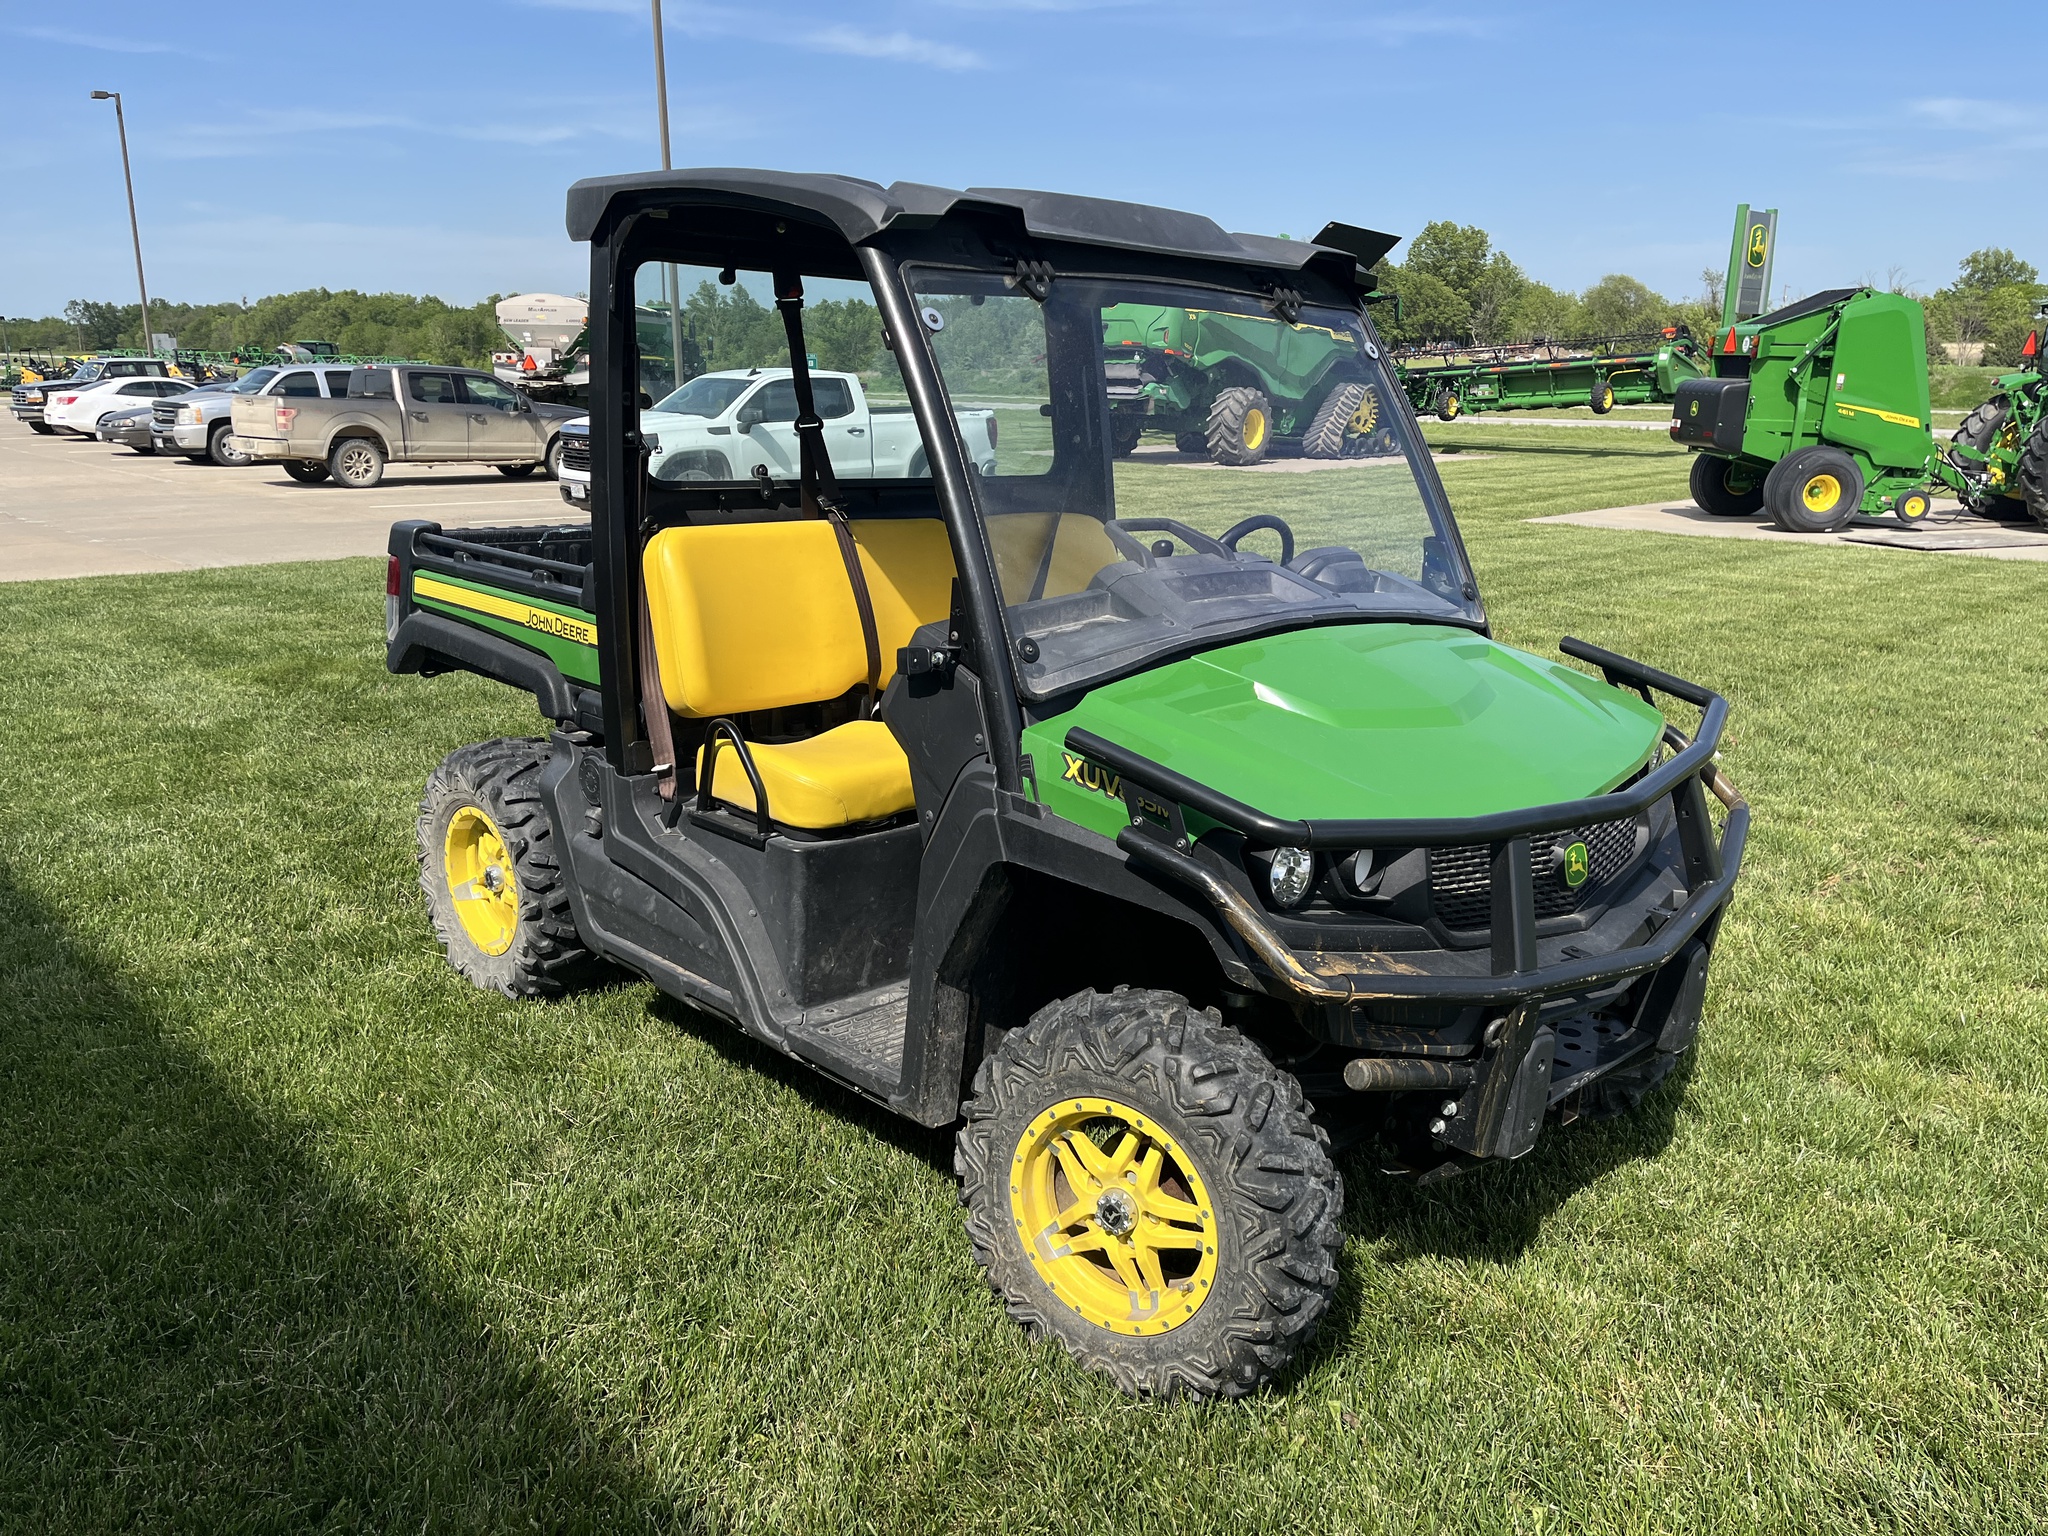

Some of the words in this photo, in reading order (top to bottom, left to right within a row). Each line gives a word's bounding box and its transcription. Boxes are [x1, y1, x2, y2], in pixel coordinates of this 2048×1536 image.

[1899, 416, 1915, 424] DEERE
[525, 609, 553, 632] JOHN
[555, 616, 589, 642] DEERE
